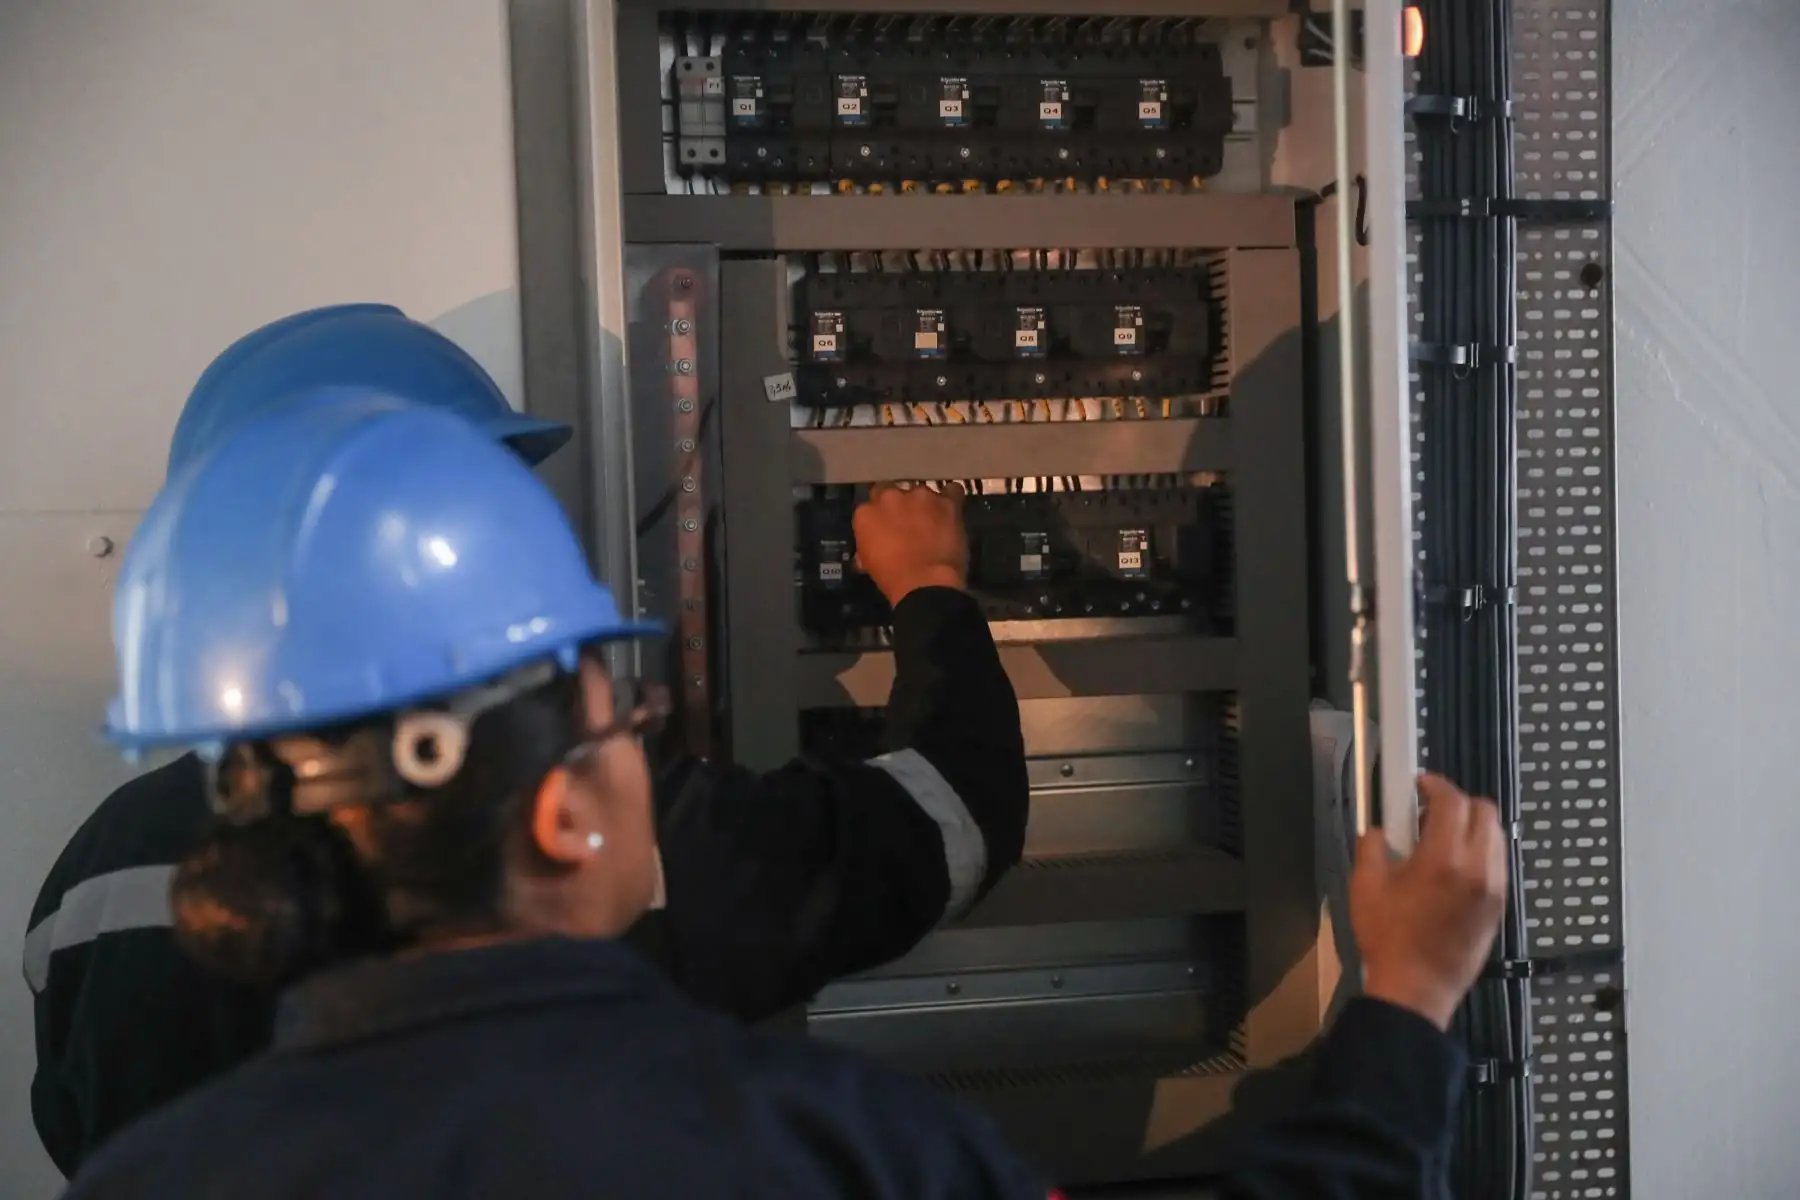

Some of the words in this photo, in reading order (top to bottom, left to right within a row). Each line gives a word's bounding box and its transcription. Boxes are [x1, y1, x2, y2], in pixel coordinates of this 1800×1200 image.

[740, 103, 752, 111] Q1
[842, 103, 857, 111] Q2
[944, 105, 959, 113] Q3
[1043, 107, 1058, 115] Q4
[1143, 107, 1157, 115] Q5
